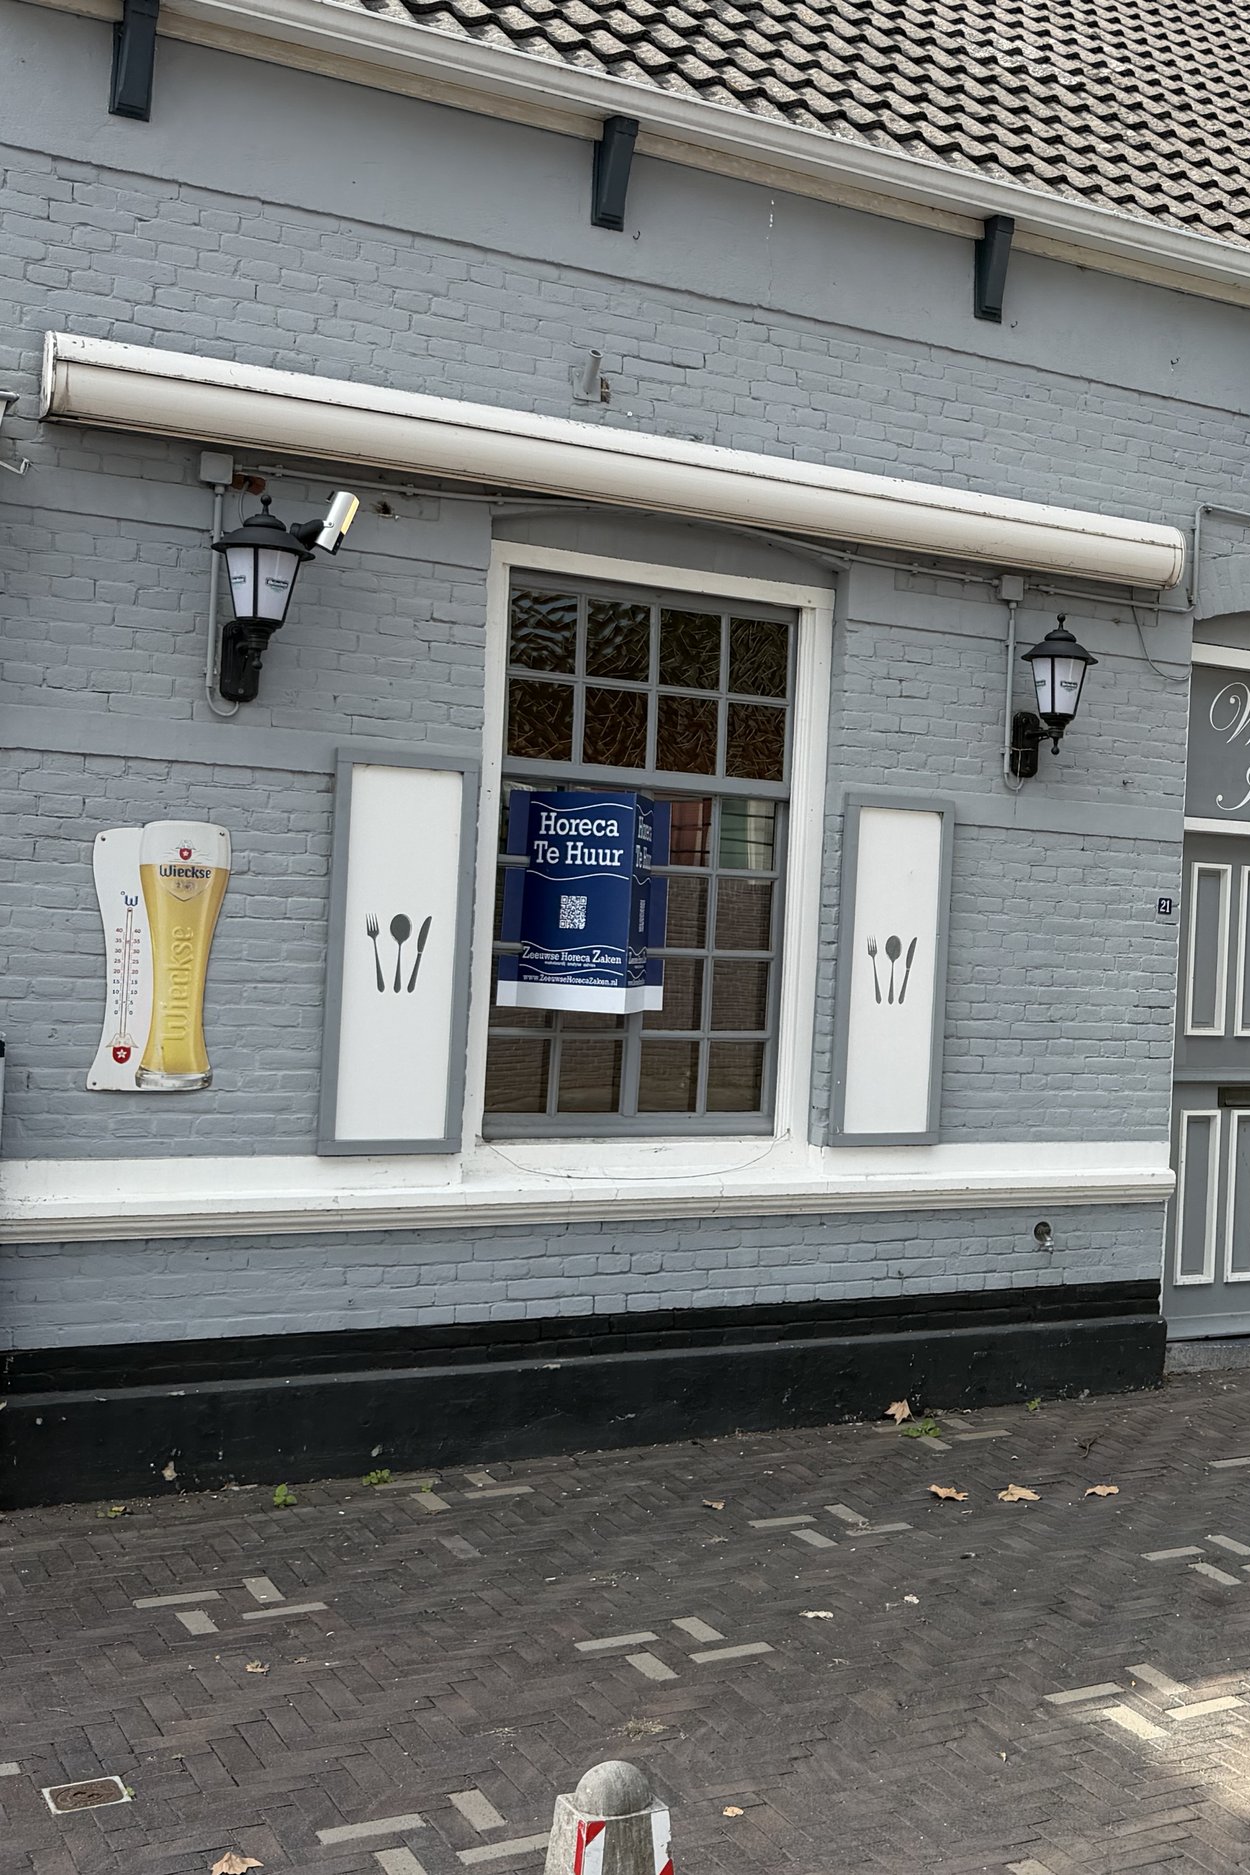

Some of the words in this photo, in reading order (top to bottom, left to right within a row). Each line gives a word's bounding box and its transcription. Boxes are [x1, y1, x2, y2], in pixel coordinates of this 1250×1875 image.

[539, 811, 620, 837] Horeca
[533, 840, 560, 864] Te
[565, 841, 624, 866] Huur
[159, 864, 212, 879] Wieckse
[1159, 900, 1171, 913] 21
[522, 946, 560, 961] Zeeuwse
[561, 952, 591, 963] Horeca
[592, 949, 622, 964] Zaken
[160, 925, 195, 1042] Wieckse
[522, 973, 618, 986] www.ZeeuwseHorecaZaken.nl
